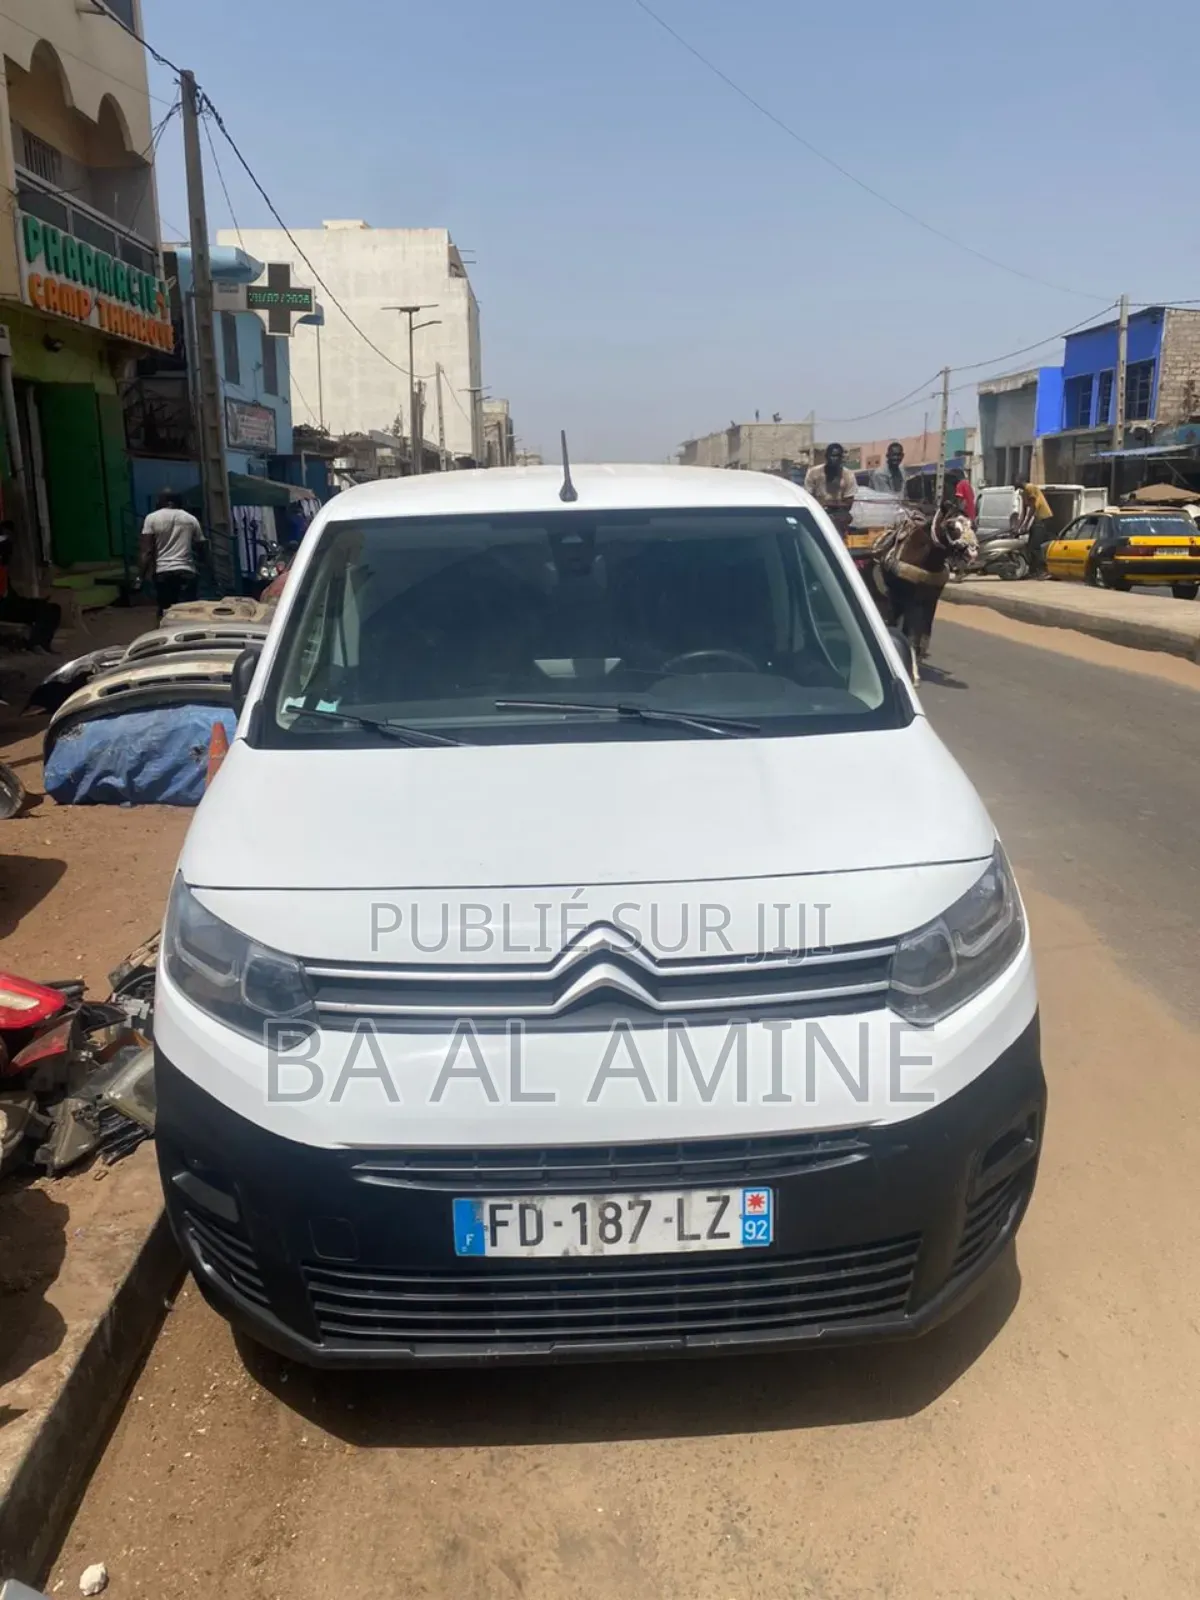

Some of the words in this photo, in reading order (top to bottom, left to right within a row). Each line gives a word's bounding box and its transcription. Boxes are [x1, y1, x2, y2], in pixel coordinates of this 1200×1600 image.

[23, 214, 158, 315] PHARMACIE
[29, 272, 92, 321] CAMP
[465, 1233, 475, 1247] F
[744, 1219, 768, 1241] 92
